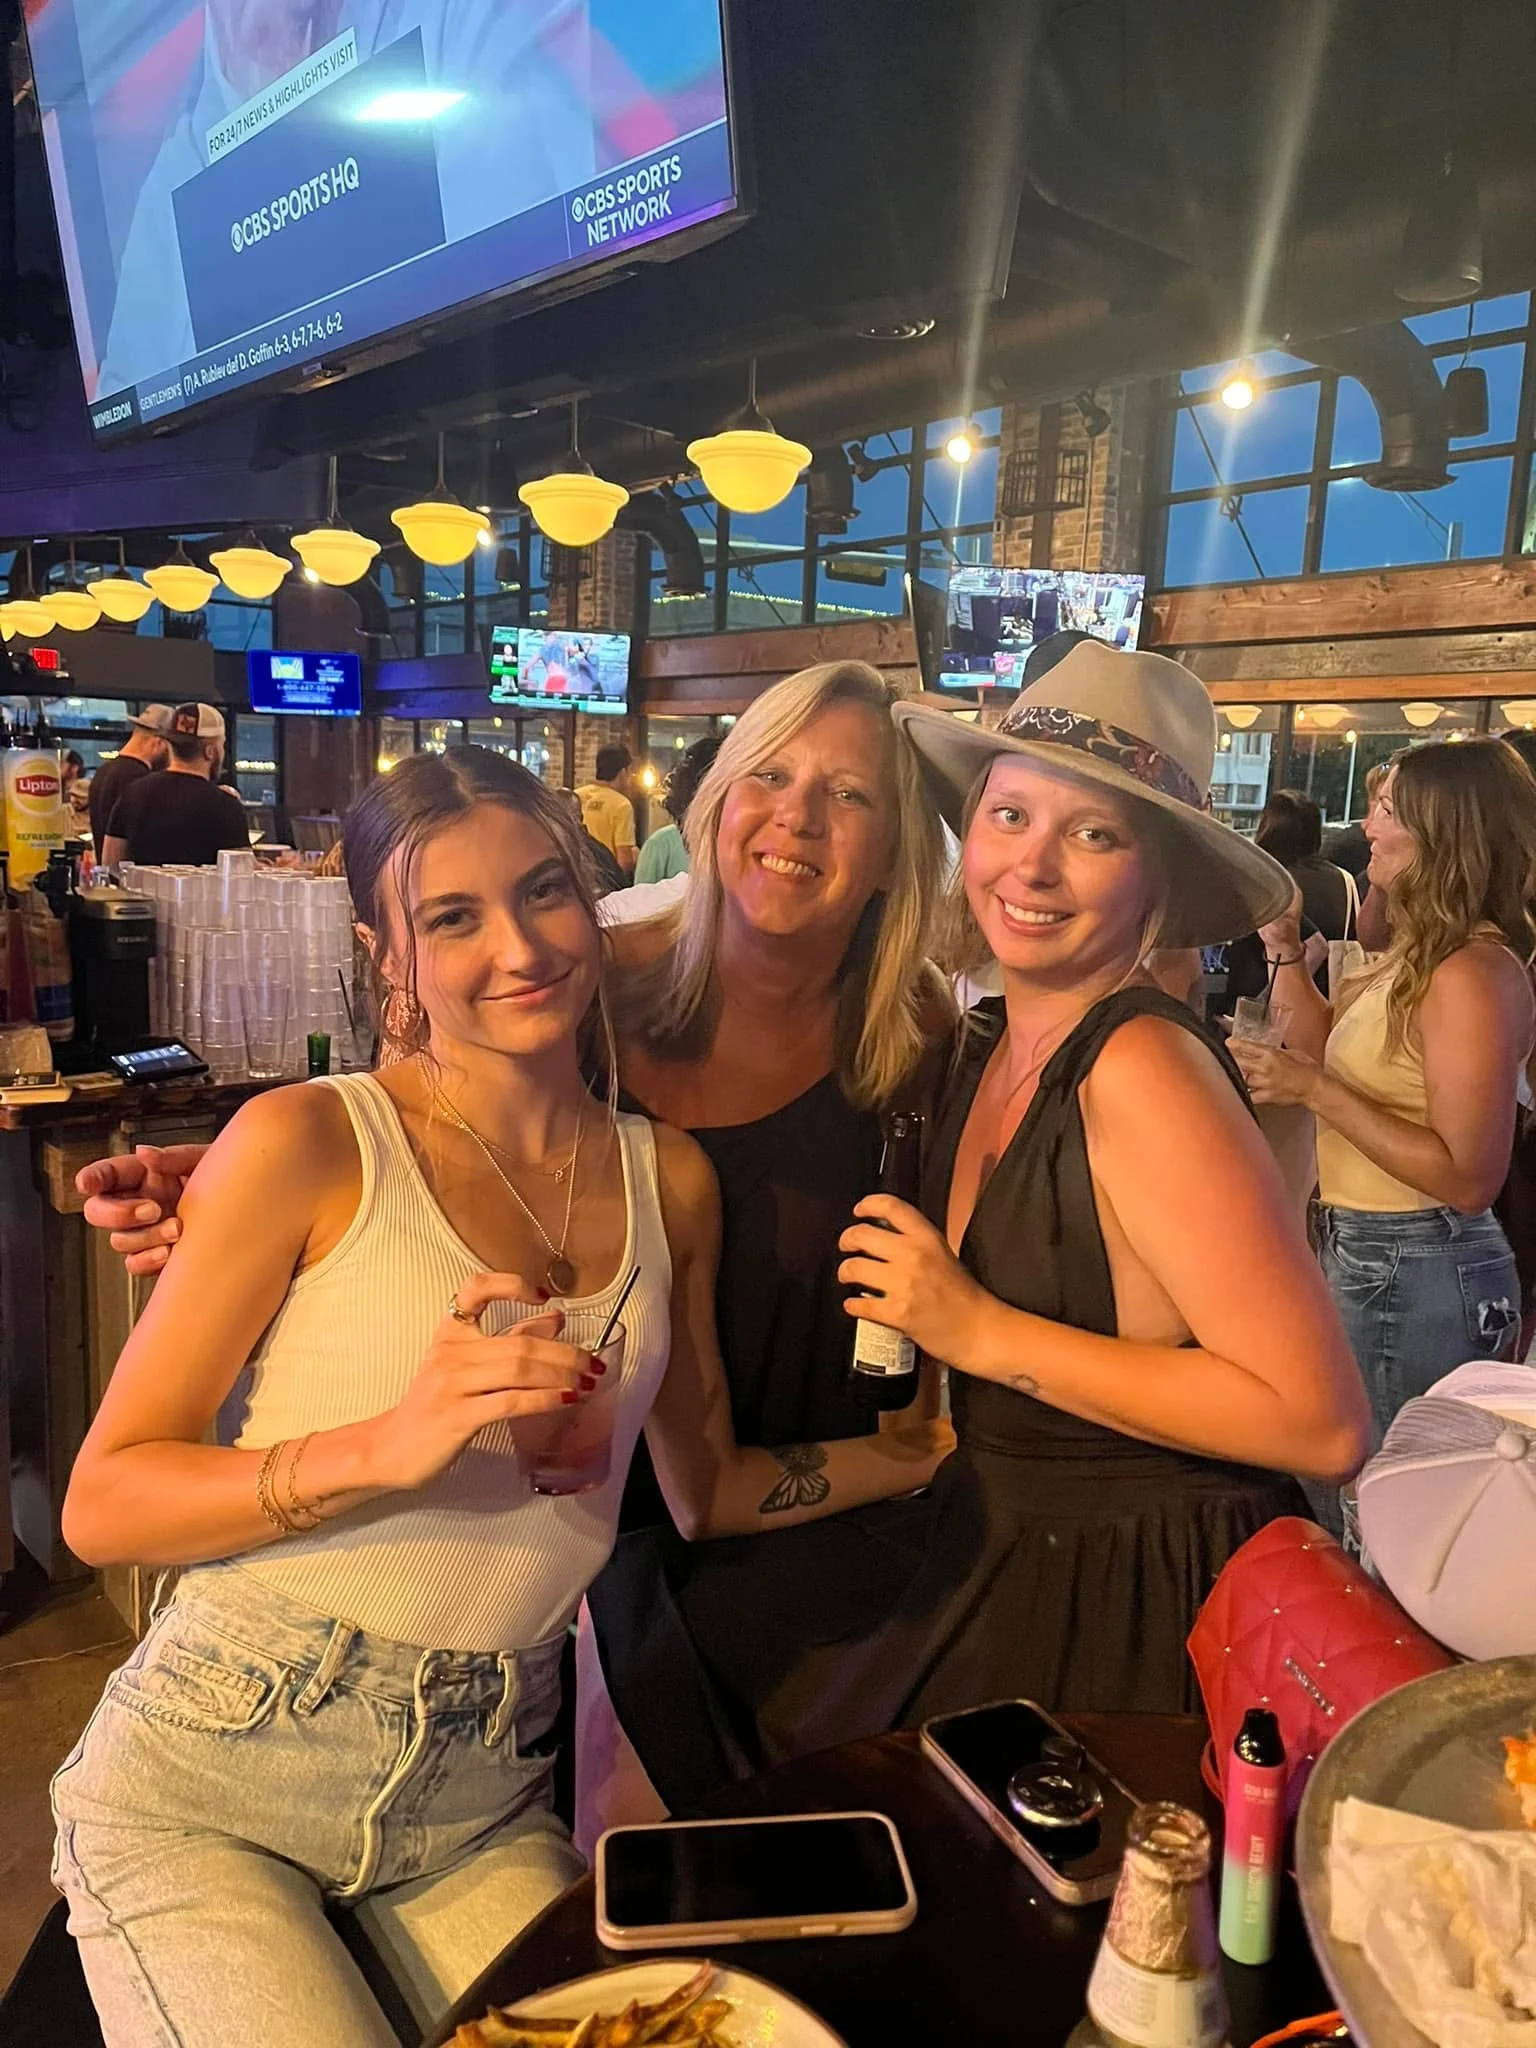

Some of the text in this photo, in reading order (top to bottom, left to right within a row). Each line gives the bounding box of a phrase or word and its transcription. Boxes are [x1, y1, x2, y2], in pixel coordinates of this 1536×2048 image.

[209, 42, 354, 154] FOR 24/7 NEWS & HIGHLIGHTS VISIT
[242, 157, 360, 246] CBS SPORTS HQ
[585, 155, 682, 217] CBS SPORTS
[587, 190, 672, 247] NETWORK
[92, 401, 133, 429] WIMBLEDON
[239, 352, 249, 370] D.
[249, 342, 275, 366] Goffin
[274, 334, 292, 355] 6-3,
[326, 312, 343, 335] 6-2
